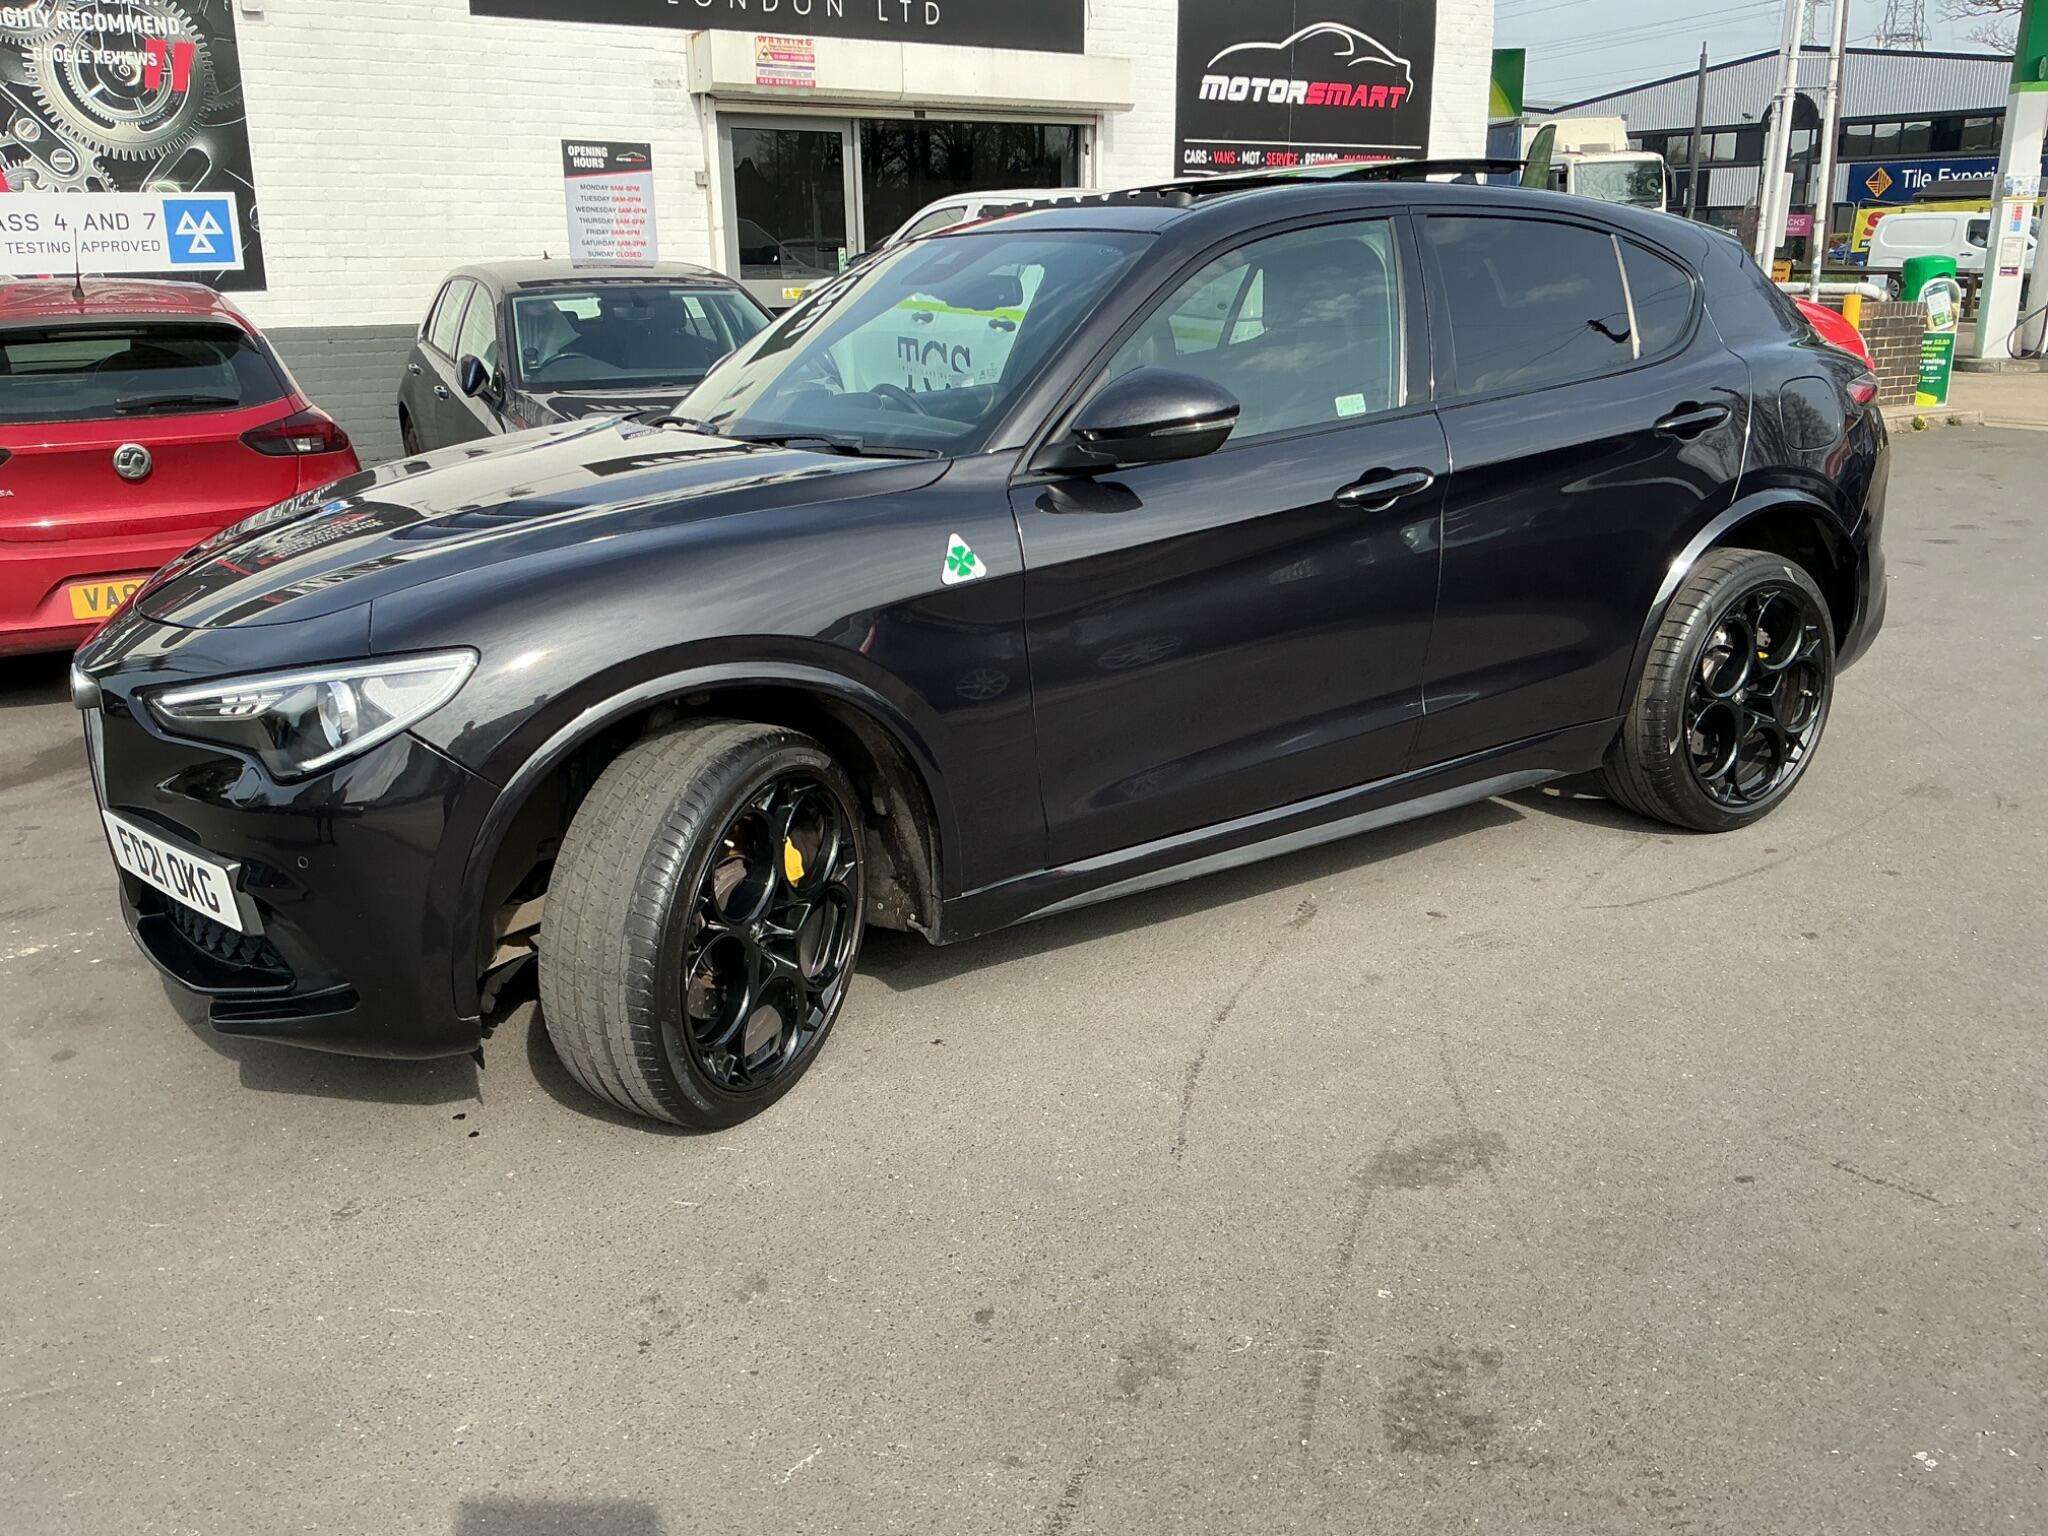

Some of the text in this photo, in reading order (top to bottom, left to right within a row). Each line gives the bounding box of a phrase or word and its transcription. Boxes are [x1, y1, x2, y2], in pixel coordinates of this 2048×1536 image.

[668, 0, 940, 26] DON LTD
[0, 6, 186, 36] GHLY RECOMMEND.
[94, 50, 158, 67] REVIEWS
[1199, 73, 1407, 109] MOTORSMART
[567, 145, 608, 158] OPENING
[1184, 149, 1207, 164] CARS
[1213, 150, 1236, 165] VANS
[1242, 151, 1261, 166] MOT
[1266, 152, 1299, 167] SERVICE
[573, 157, 605, 169] HOURS
[1902, 168, 1932, 189] Tile
[575, 206, 617, 214] WEDNESDAY
[54, 213, 68, 231] 4
[83, 212, 130, 231] AND
[142, 212, 157, 231] 7
[579, 217, 614, 225] THURSDAY
[585, 228, 609, 236] FRIDAY
[5, 240, 161, 254] TESTING APPROVED
[581, 239, 616, 247] SATURDAY
[587, 250, 614, 258] SUNDAY
[116, 824, 221, 914] FD21 OKG
